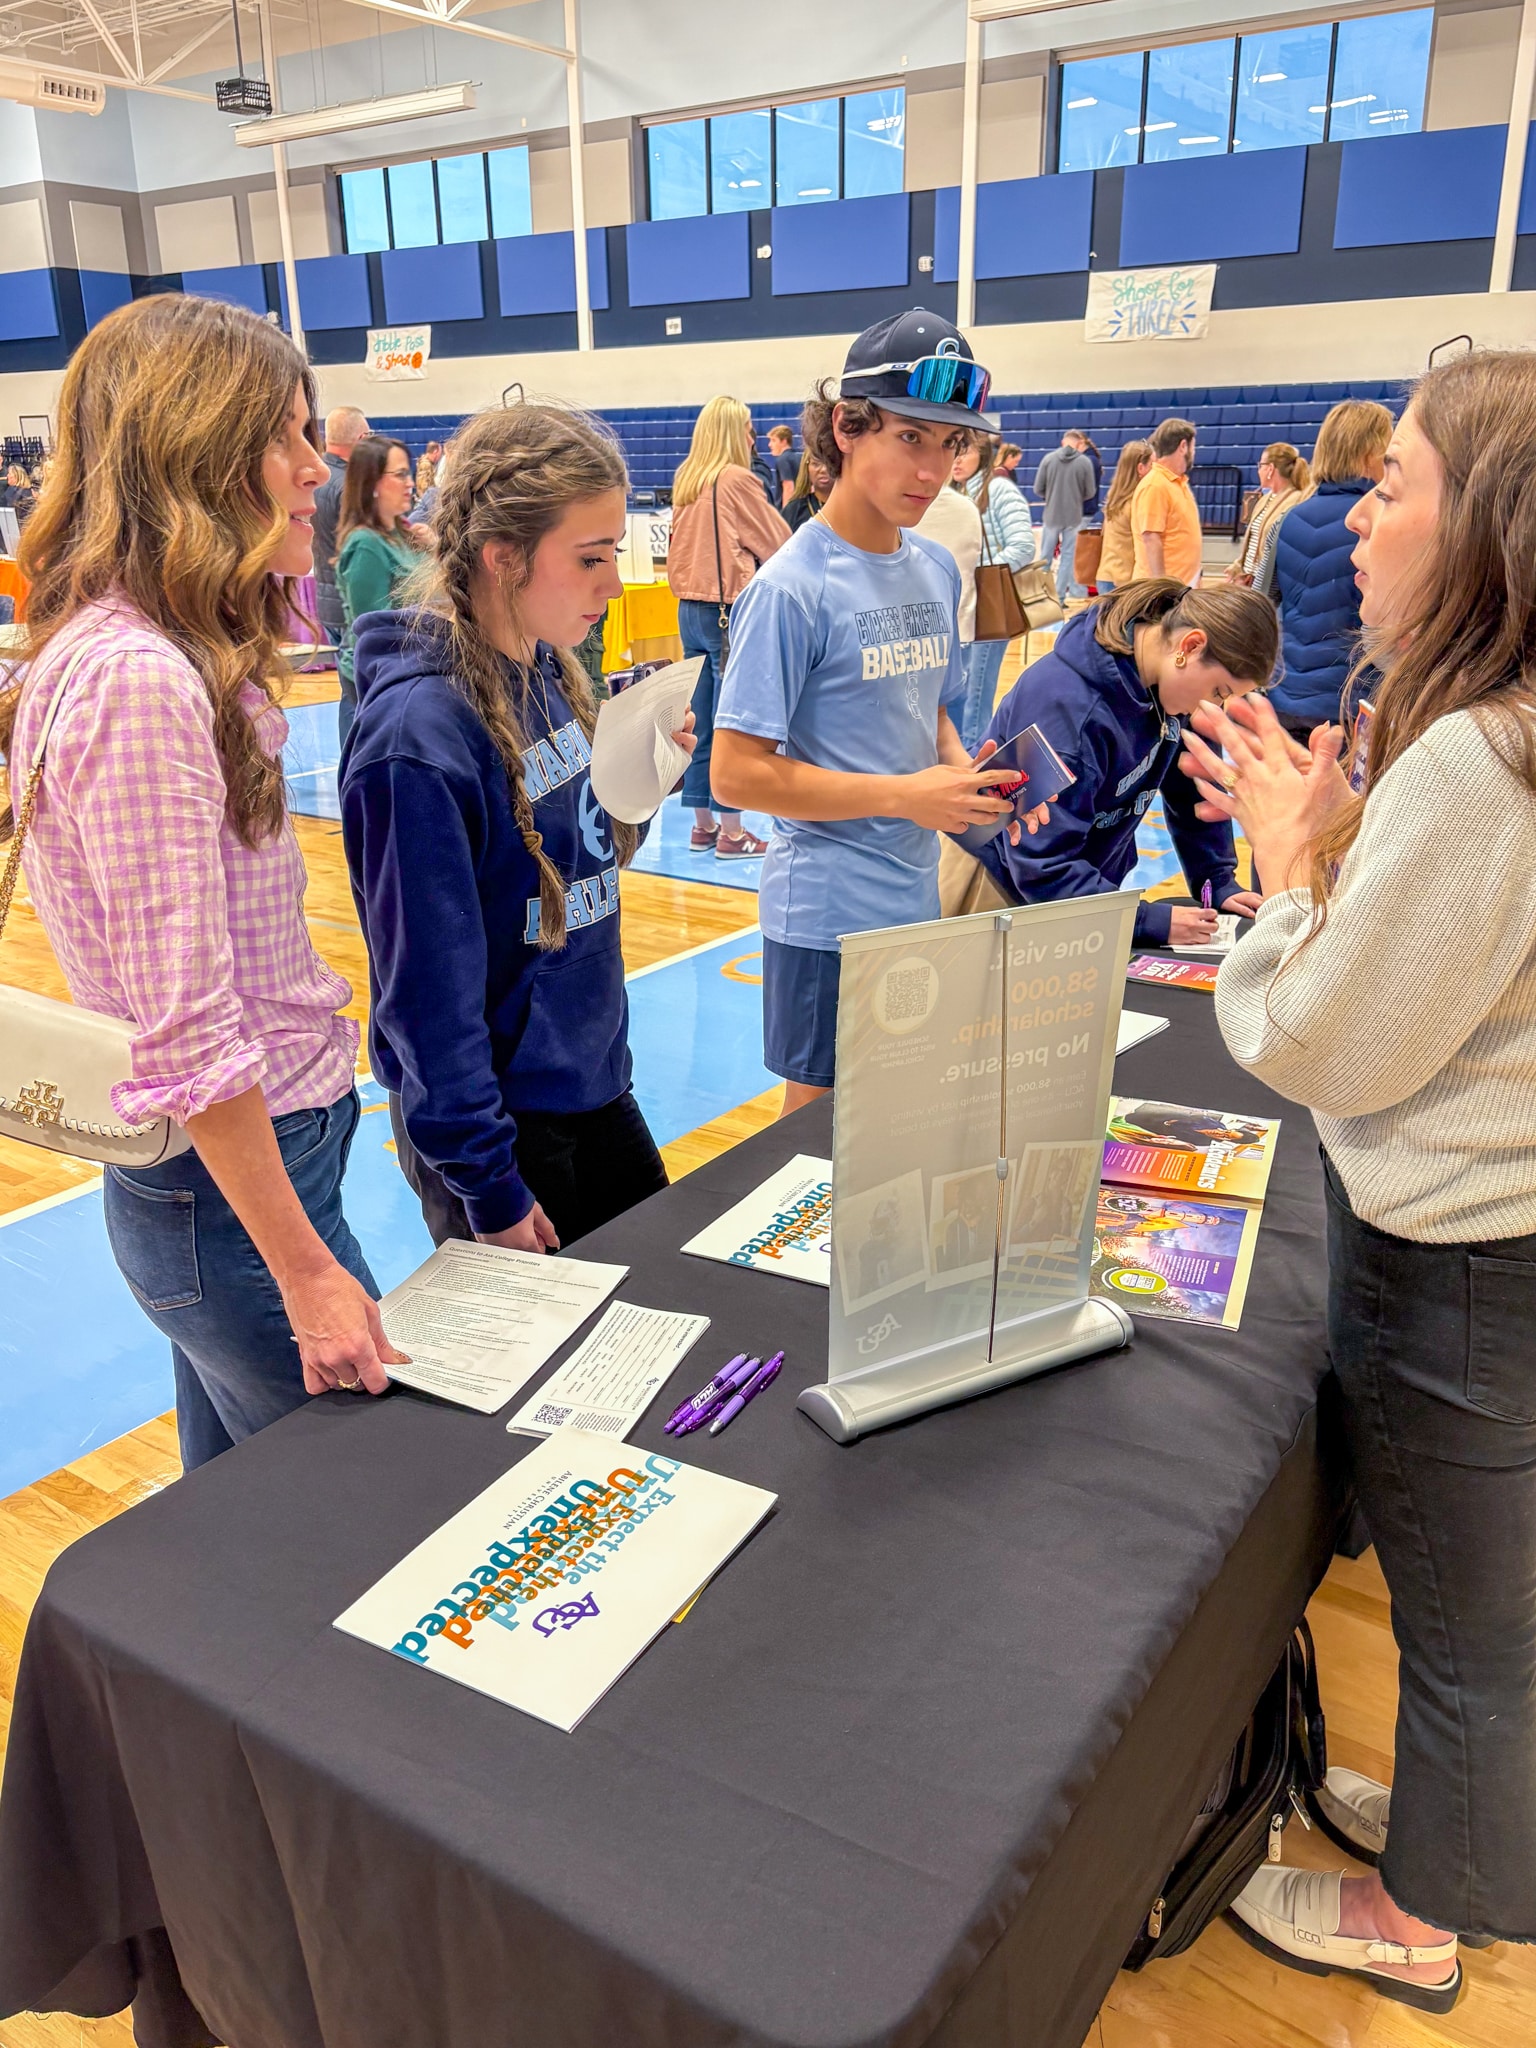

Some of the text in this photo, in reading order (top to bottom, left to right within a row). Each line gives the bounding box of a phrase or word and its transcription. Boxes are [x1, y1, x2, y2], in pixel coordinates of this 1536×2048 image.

[1112, 271, 1195, 306] Shoot for
[1122, 299, 1182, 336] THREE
[855, 602, 950, 646] CYPRESS CHRISTIAN
[861, 635, 949, 681] BASEBALL
[742, 841, 757, 853] N
[450, 1247, 477, 1257] Questions
[516, 1258, 540, 1267] Priorities
[503, 1470, 573, 1530] ABILENE CHRISTIAN
[564, 1488, 677, 1585] Expect the
[391, 1479, 612, 1664] Unexpected
